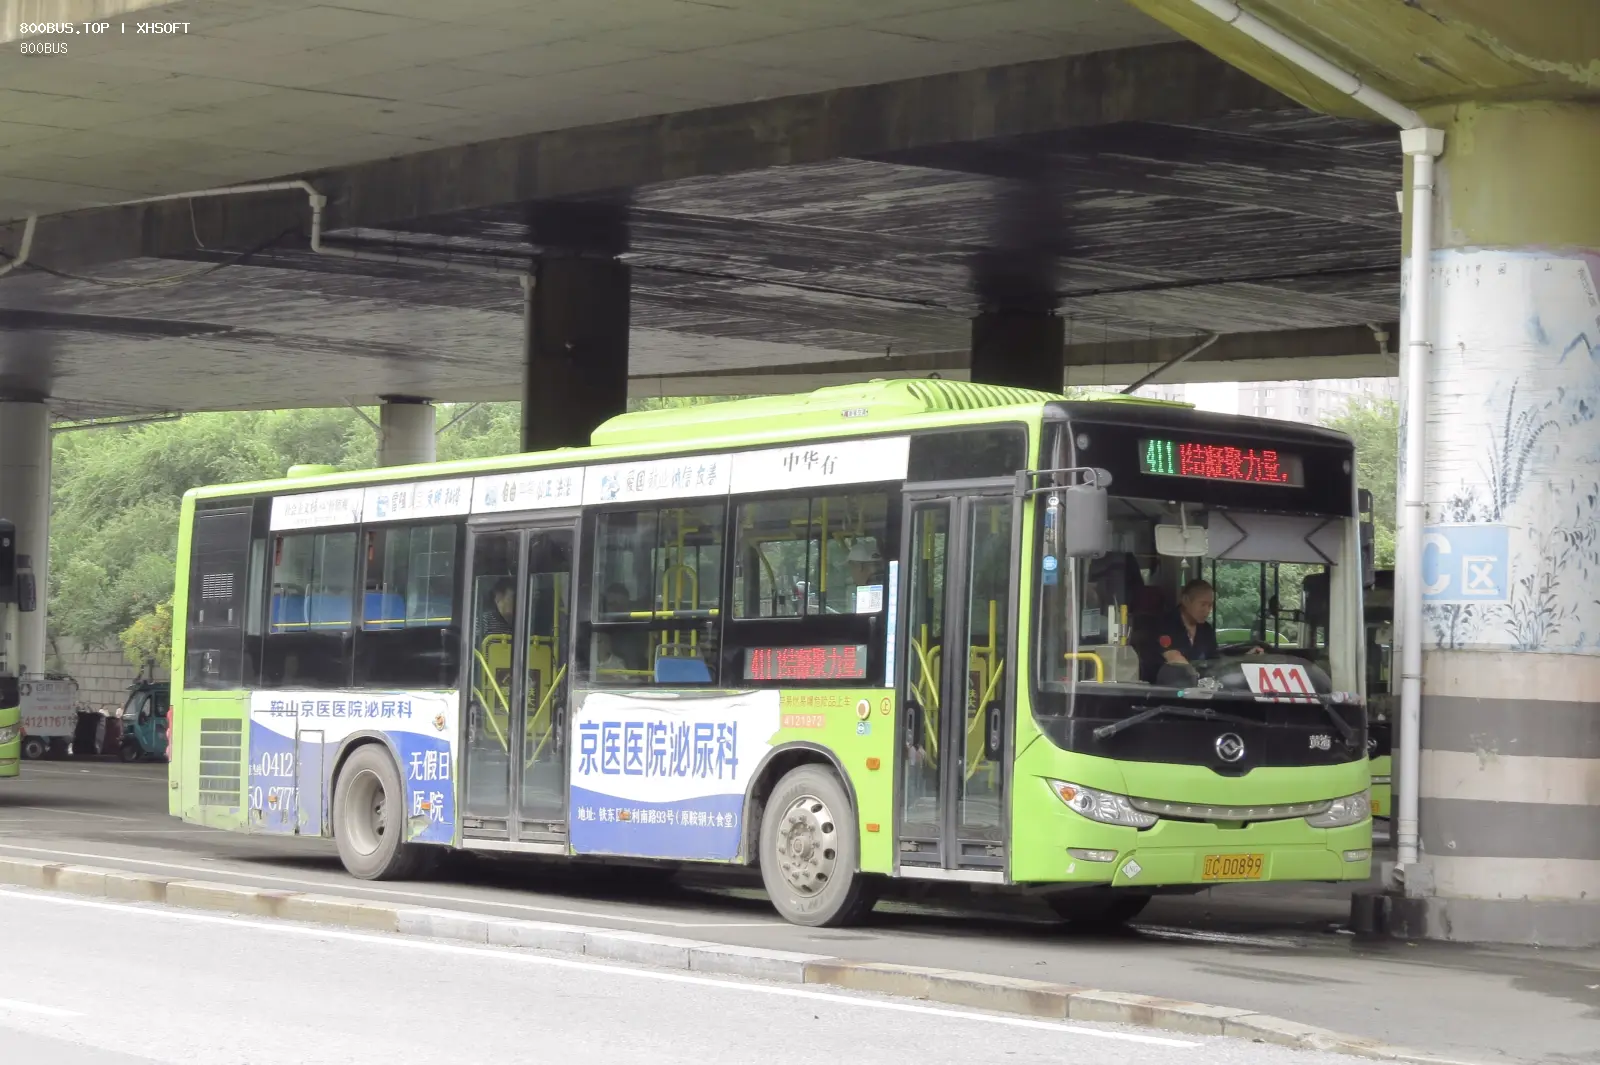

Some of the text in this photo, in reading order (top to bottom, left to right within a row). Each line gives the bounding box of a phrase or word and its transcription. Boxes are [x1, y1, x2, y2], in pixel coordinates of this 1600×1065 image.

[1146, 440, 1174, 474] 411
[752, 648, 772, 680] 411
[1259, 667, 1312, 704] 411
[270, 700, 412, 718] 鞍山京医医院泌尿科
[409, 750, 449, 780] 无假日
[578, 720, 739, 780] 京医医院泌尿科
[413, 790, 444, 822] 医院
